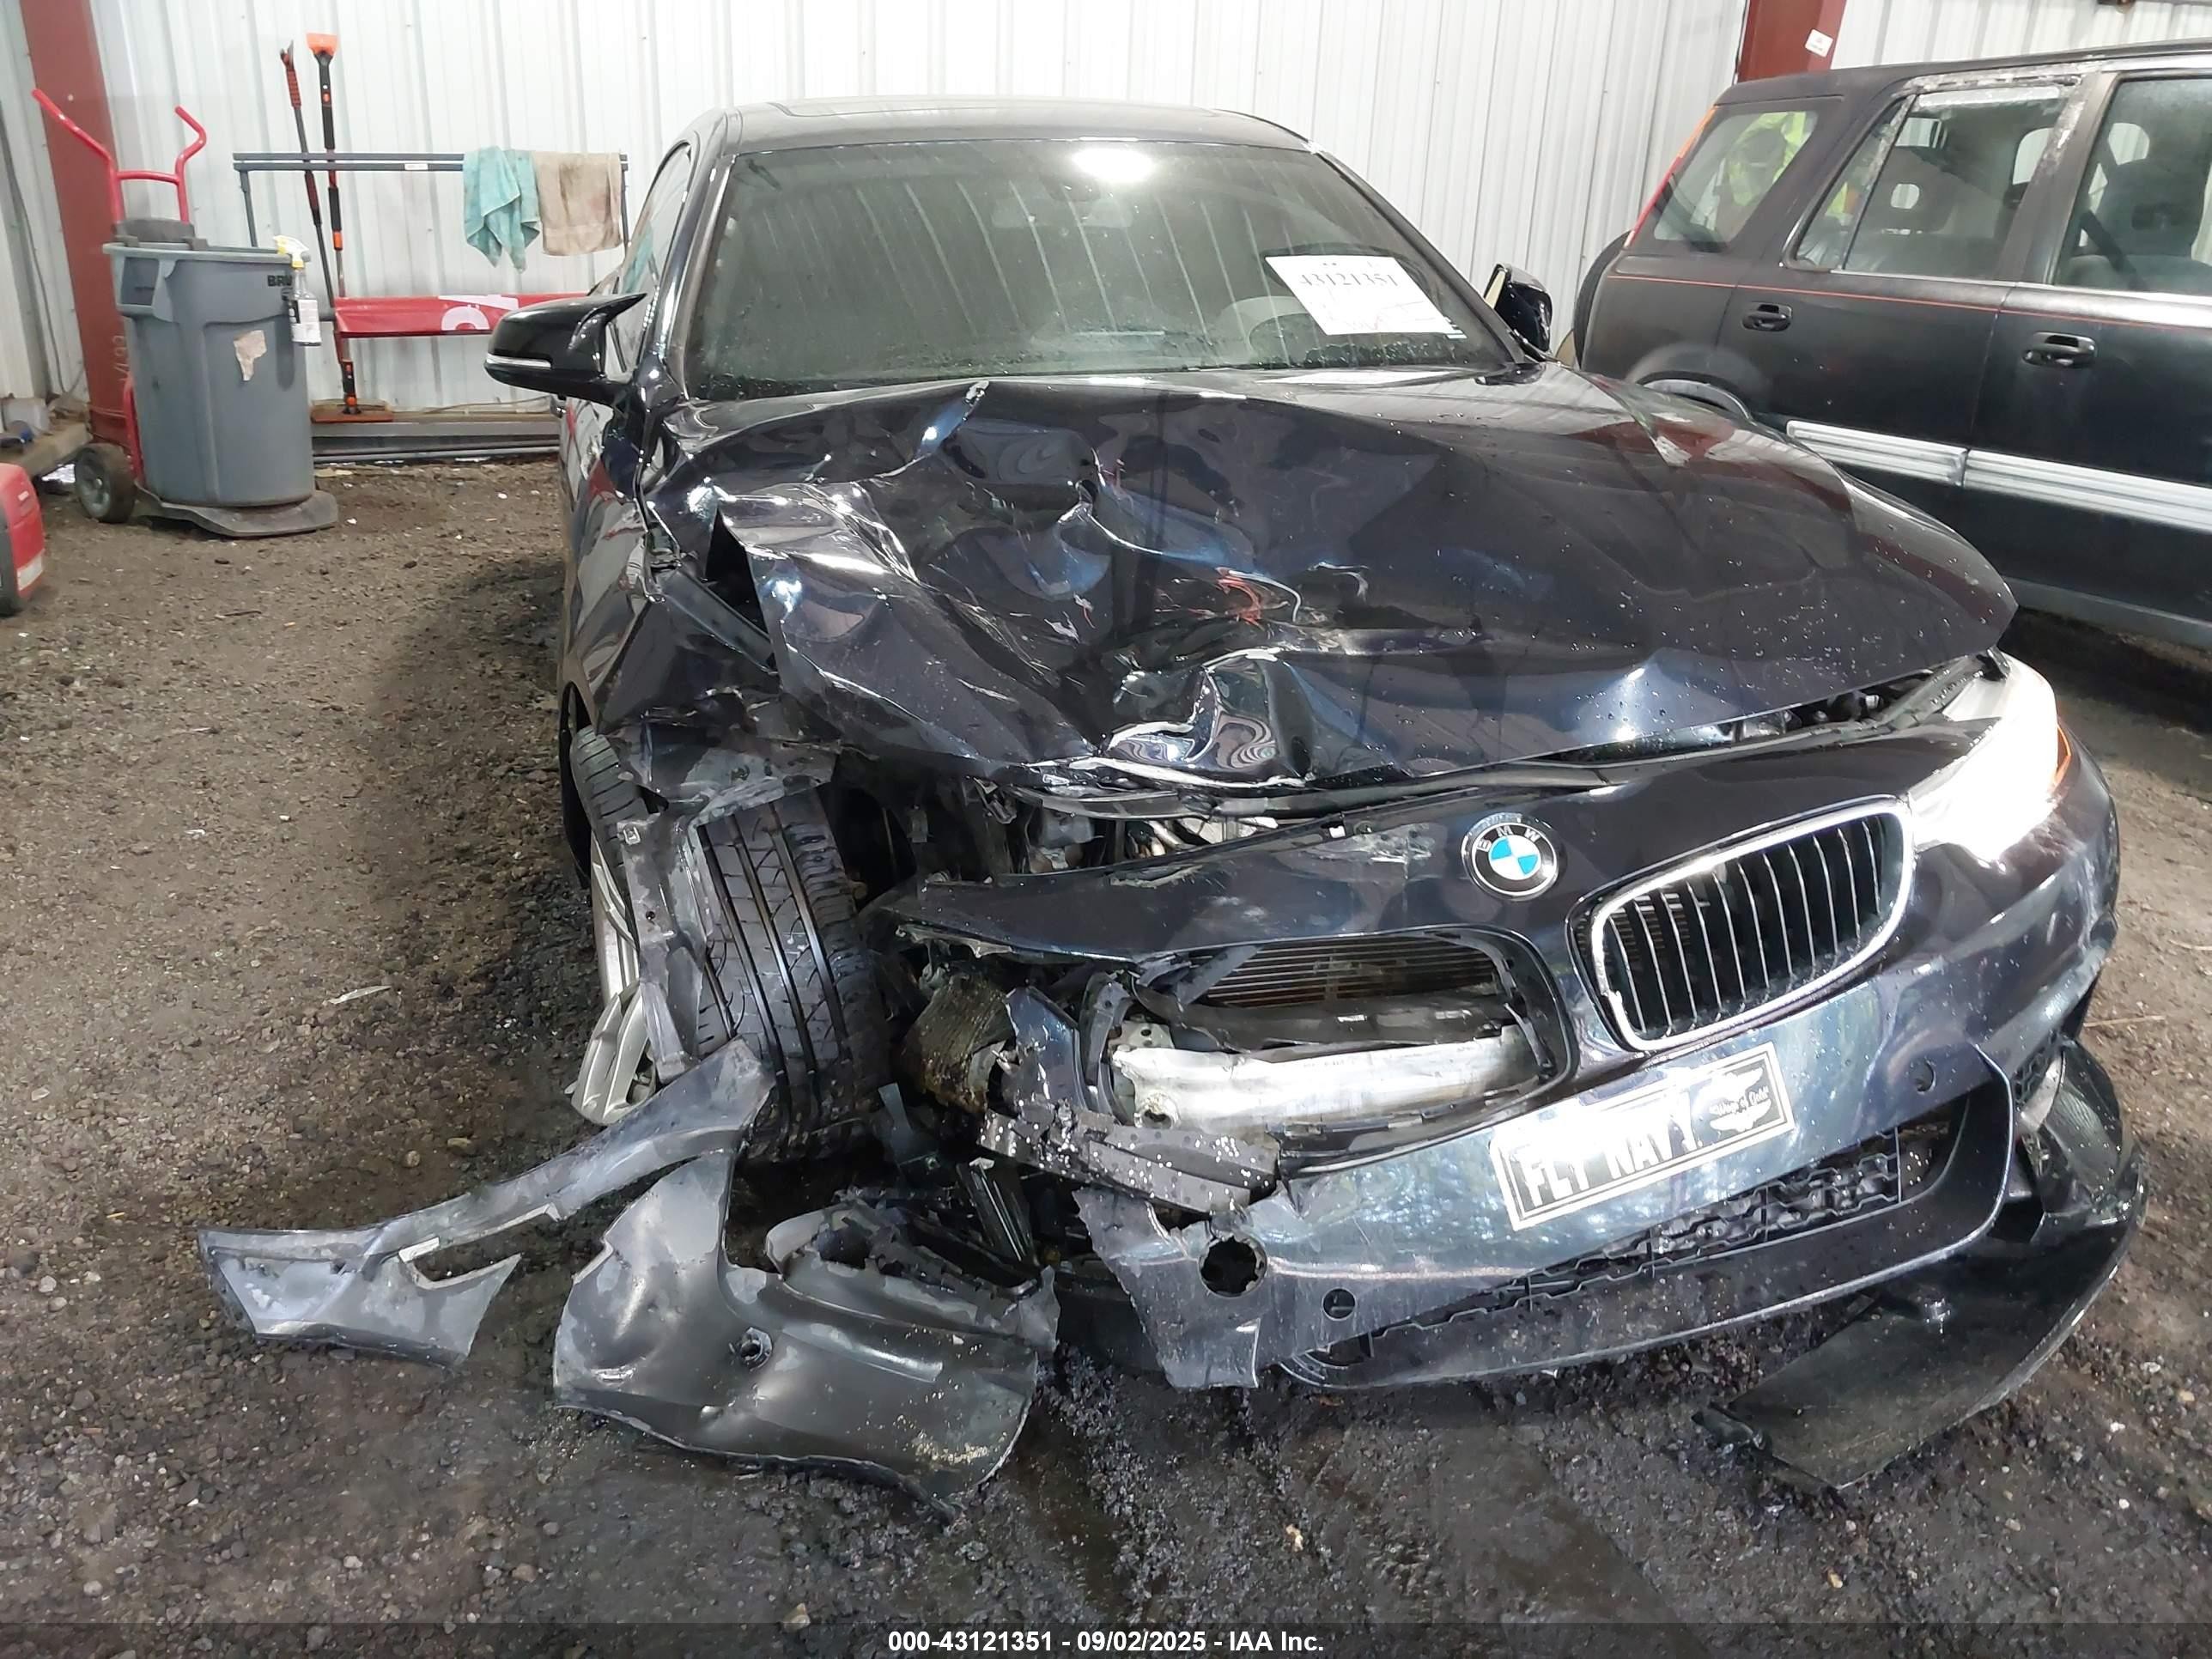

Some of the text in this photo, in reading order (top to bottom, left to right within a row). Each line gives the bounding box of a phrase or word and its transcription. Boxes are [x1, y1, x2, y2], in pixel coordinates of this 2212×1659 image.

[1476, 824, 1541, 853] BMW
[1511, 1089, 1698, 1207] FLY NAVY
